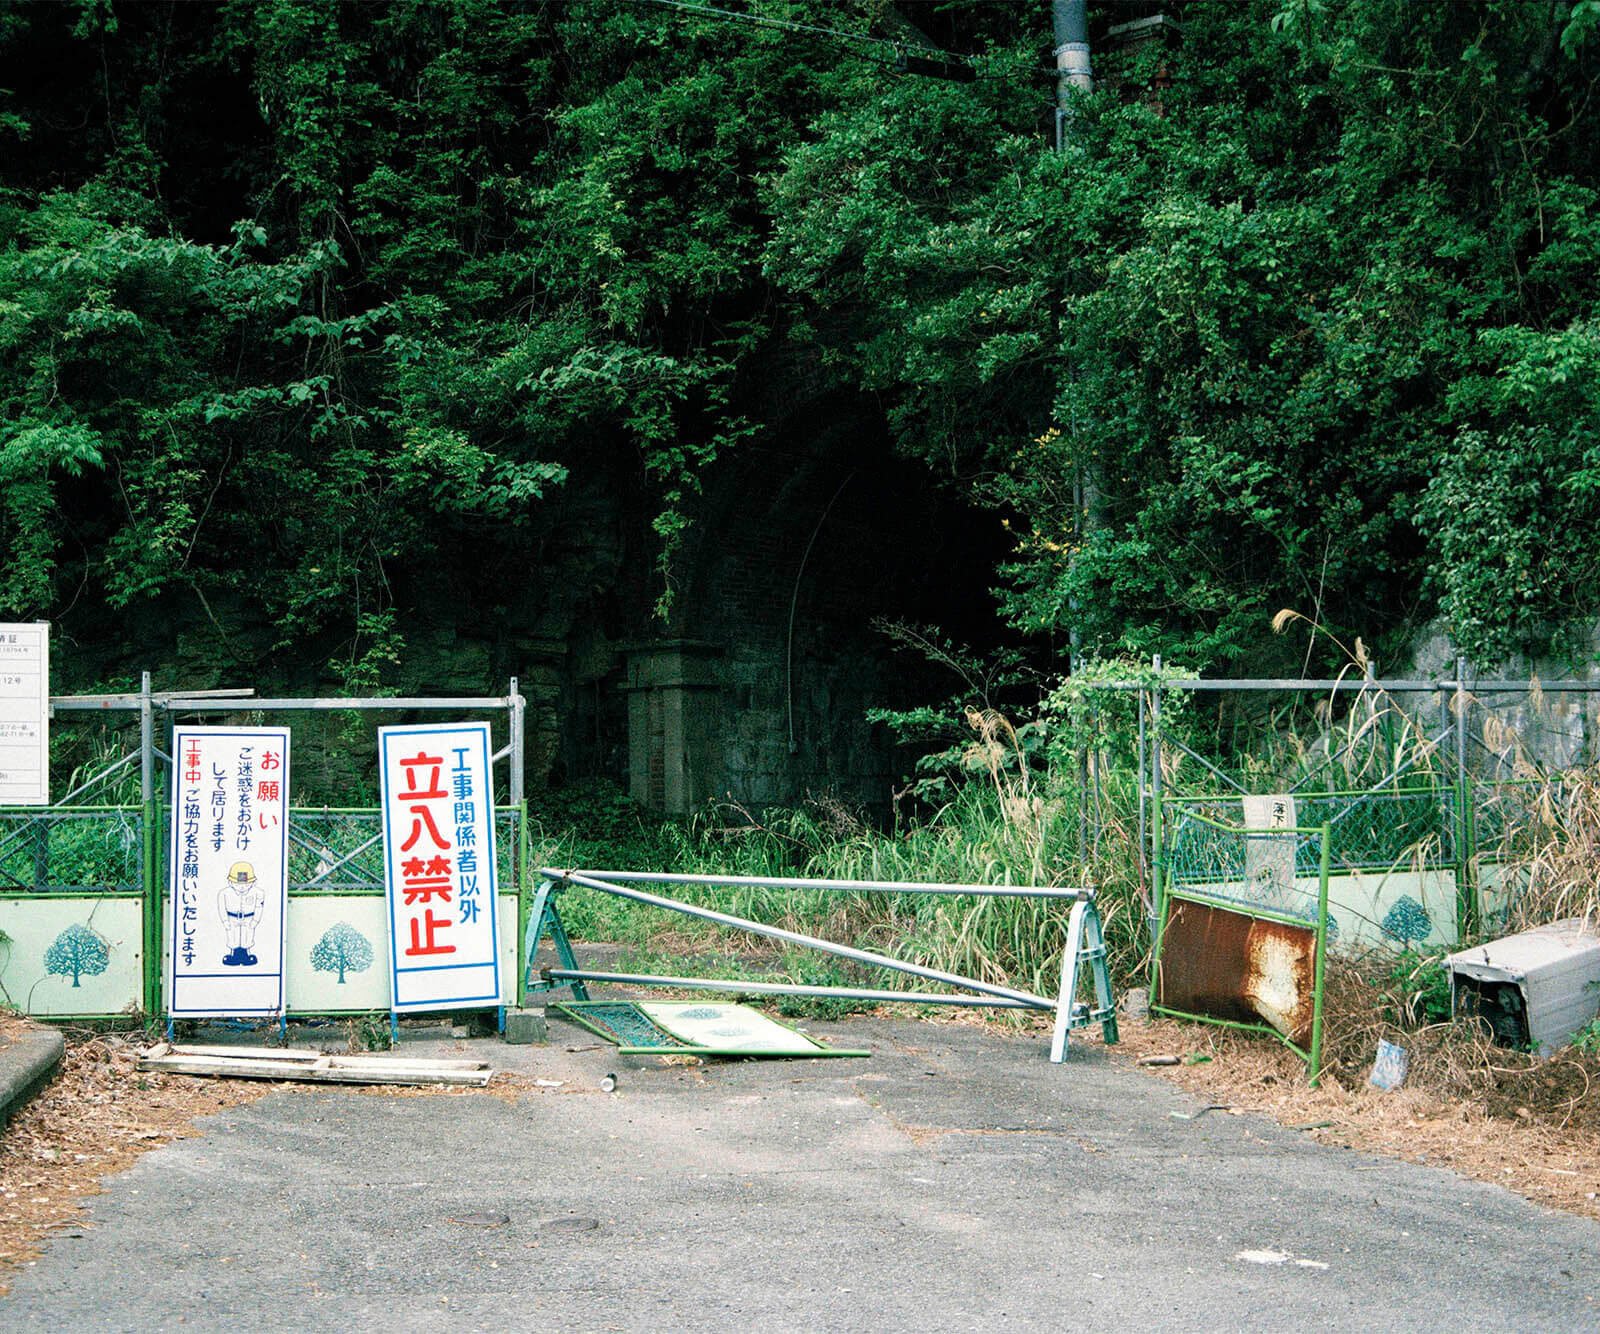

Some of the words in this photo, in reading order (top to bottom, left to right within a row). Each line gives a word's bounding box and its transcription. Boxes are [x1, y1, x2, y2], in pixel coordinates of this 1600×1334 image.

[185, 739, 201, 784] 工事中
[211, 762, 226, 852] して居ります
[236, 746, 253, 851] ご迷惑をおかけ
[257, 751, 280, 830] お願い
[182, 789, 200, 966] ご協力をお願いいたします
[451, 747, 481, 924] 工事関係者以外
